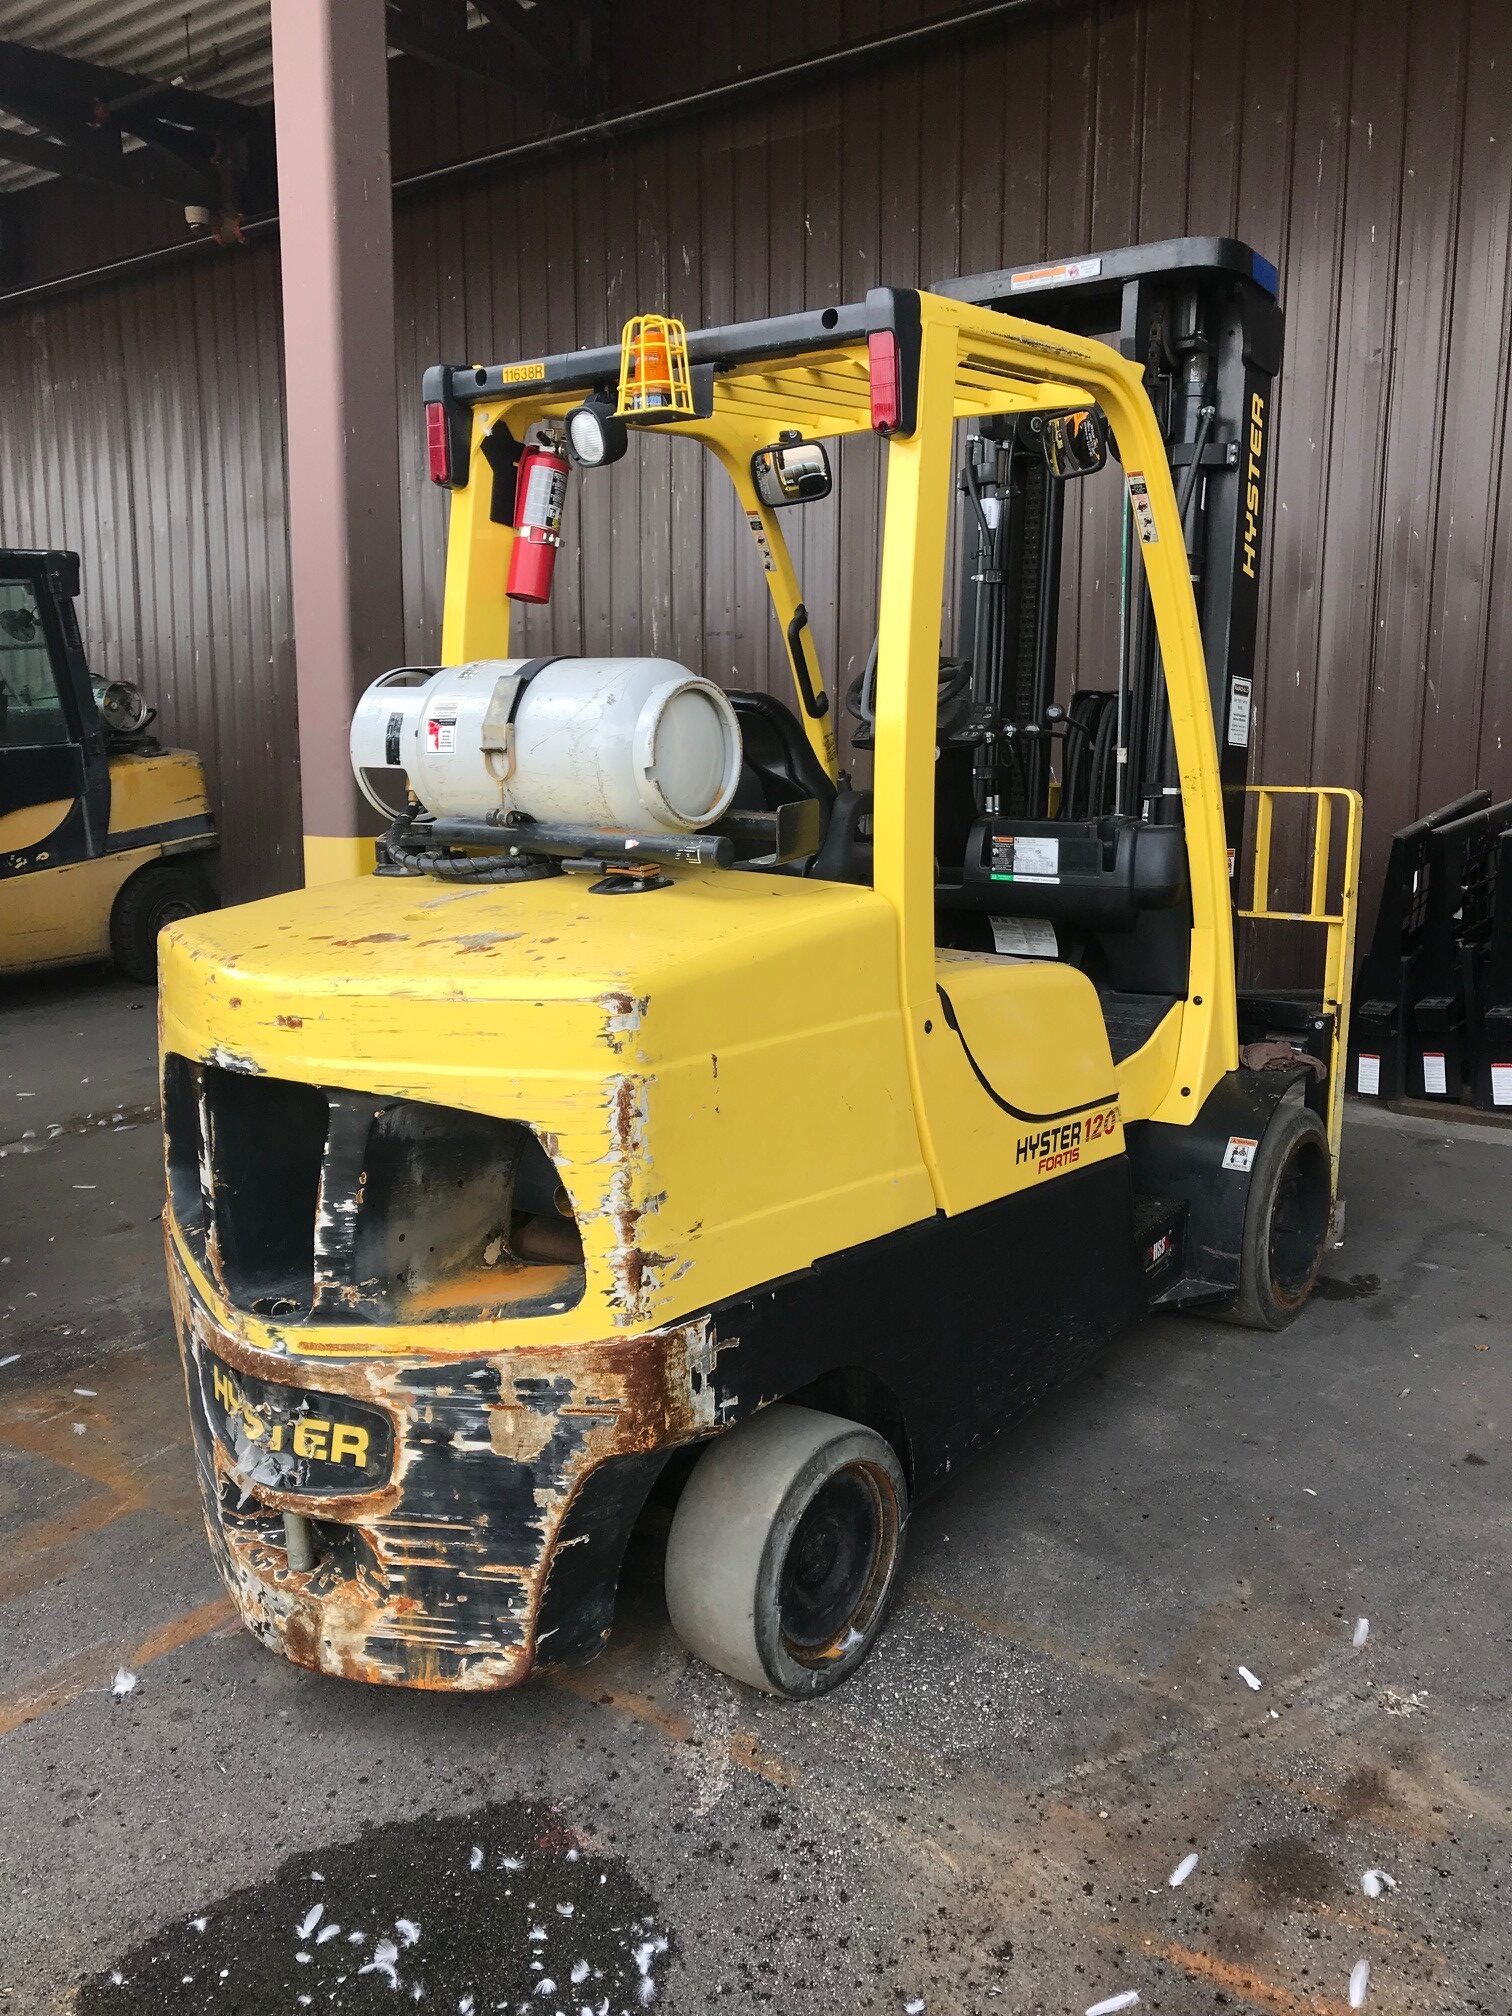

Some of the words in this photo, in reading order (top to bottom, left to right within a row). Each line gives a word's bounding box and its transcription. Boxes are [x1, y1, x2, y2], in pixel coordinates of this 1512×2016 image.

[504, 365, 543, 382] 11638R
[1242, 392, 1265, 579] HYSTER
[1015, 1121, 1082, 1166] HYSTER
[1084, 1109, 1117, 1143] 120
[1037, 1146, 1080, 1175] FORTIS
